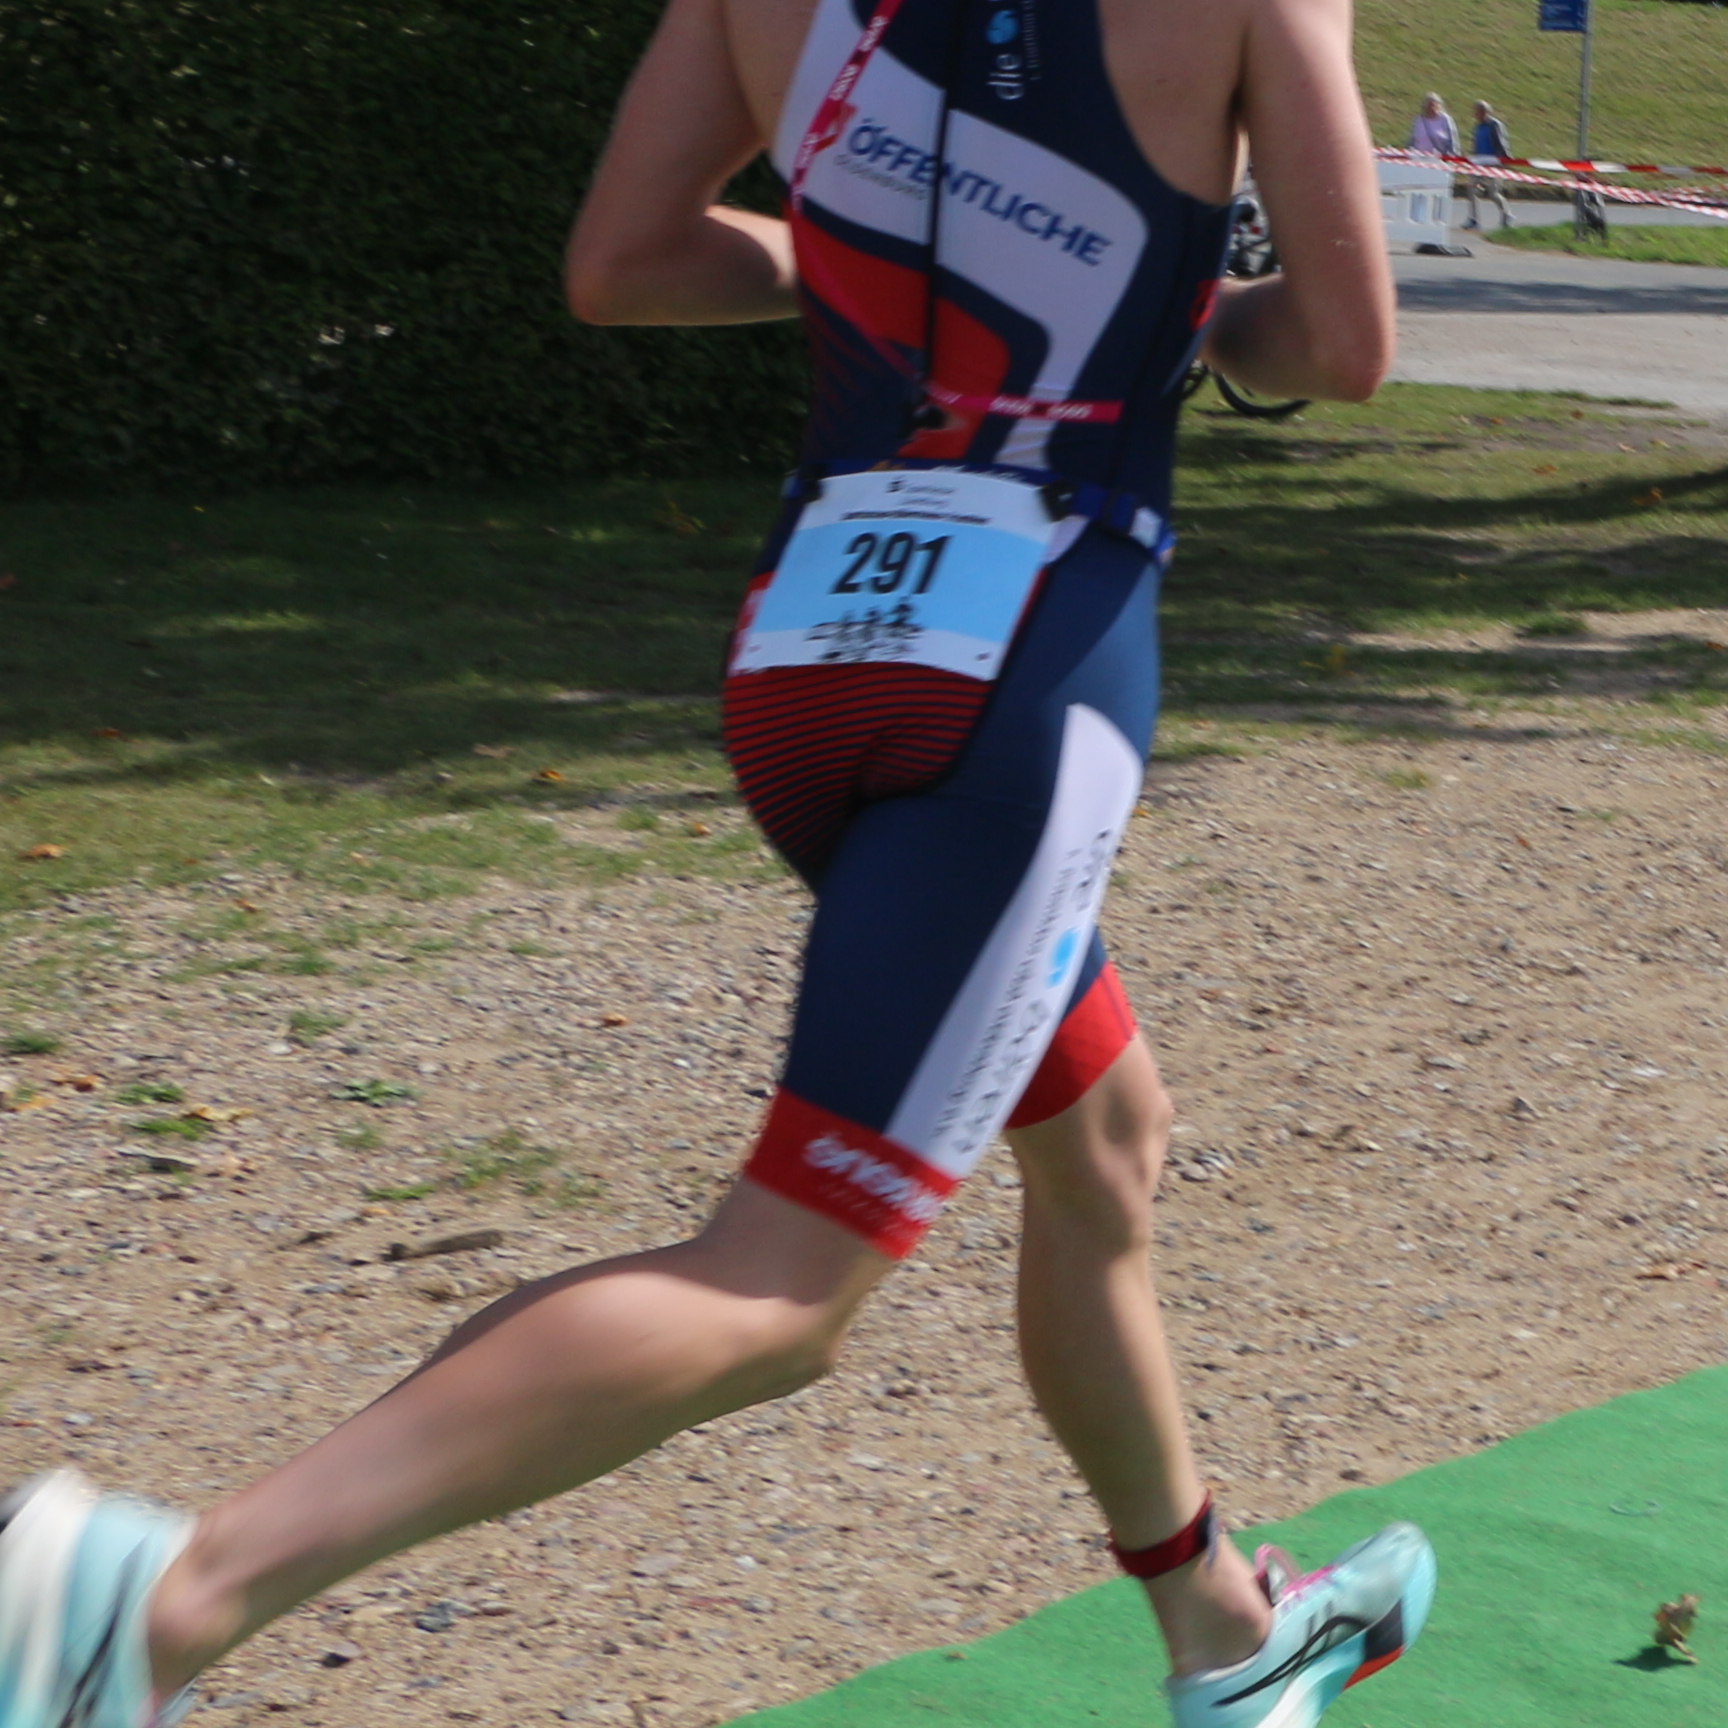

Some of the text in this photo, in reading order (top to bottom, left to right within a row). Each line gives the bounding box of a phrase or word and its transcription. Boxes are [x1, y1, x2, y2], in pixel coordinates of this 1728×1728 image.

[987, 53, 1024, 101] die
[848, 118, 1112, 267] ÖFFENTLICHE
[829, 532, 952, 595] 291
